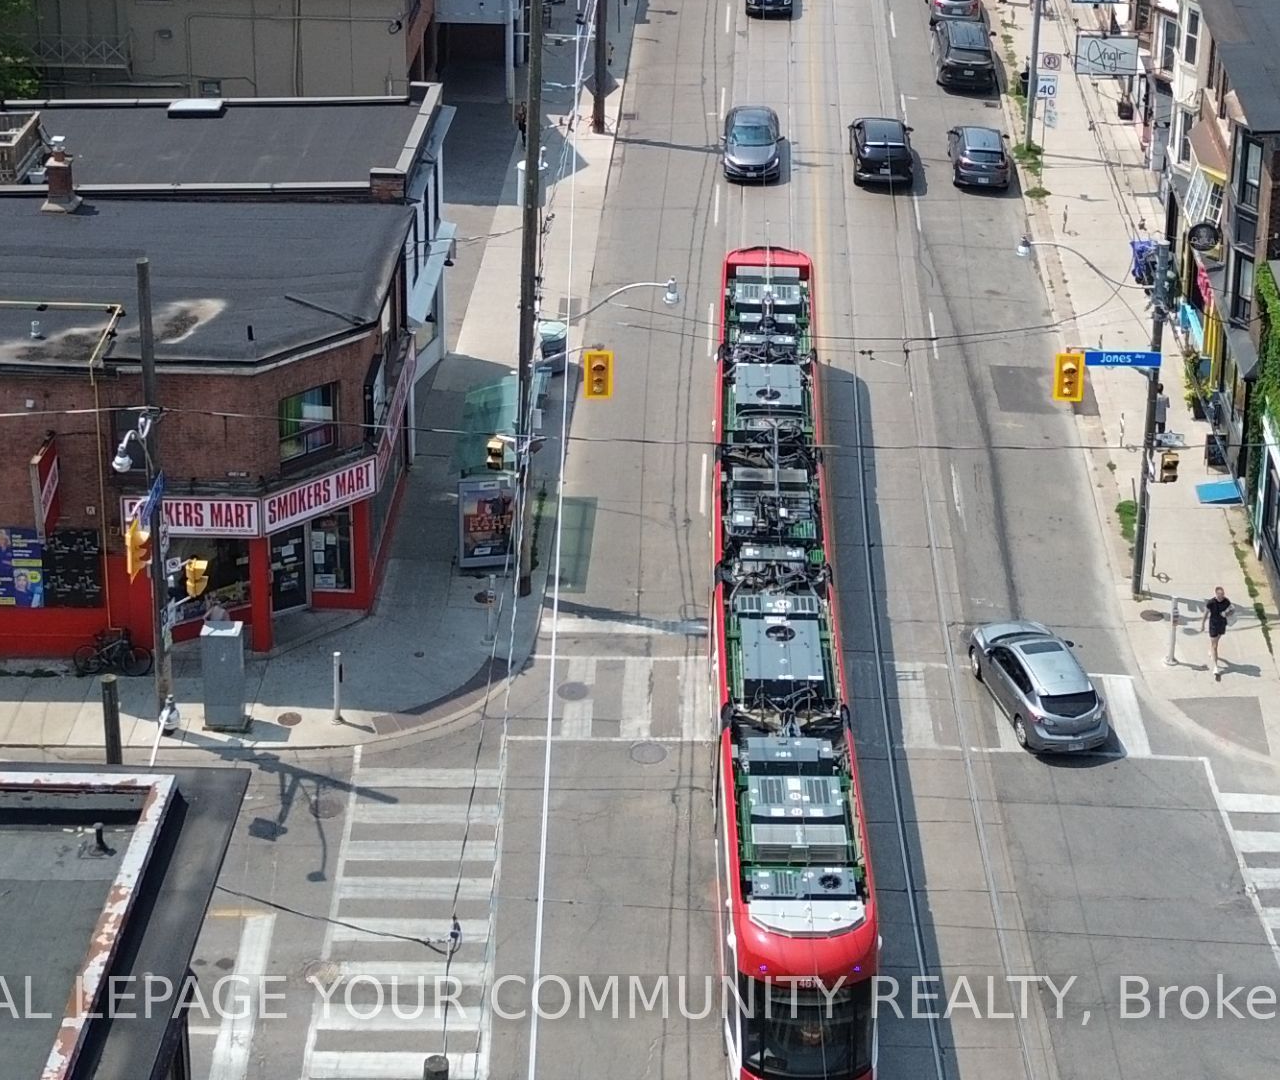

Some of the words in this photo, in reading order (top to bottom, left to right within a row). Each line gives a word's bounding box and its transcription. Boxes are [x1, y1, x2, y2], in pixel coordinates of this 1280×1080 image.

[1039, 84, 1056, 96] 40
[1100, 353, 1132, 364] Jones
[268, 477, 331, 525] SMOKERS
[336, 463, 371, 498] MART
[210, 502, 254, 528] MART
